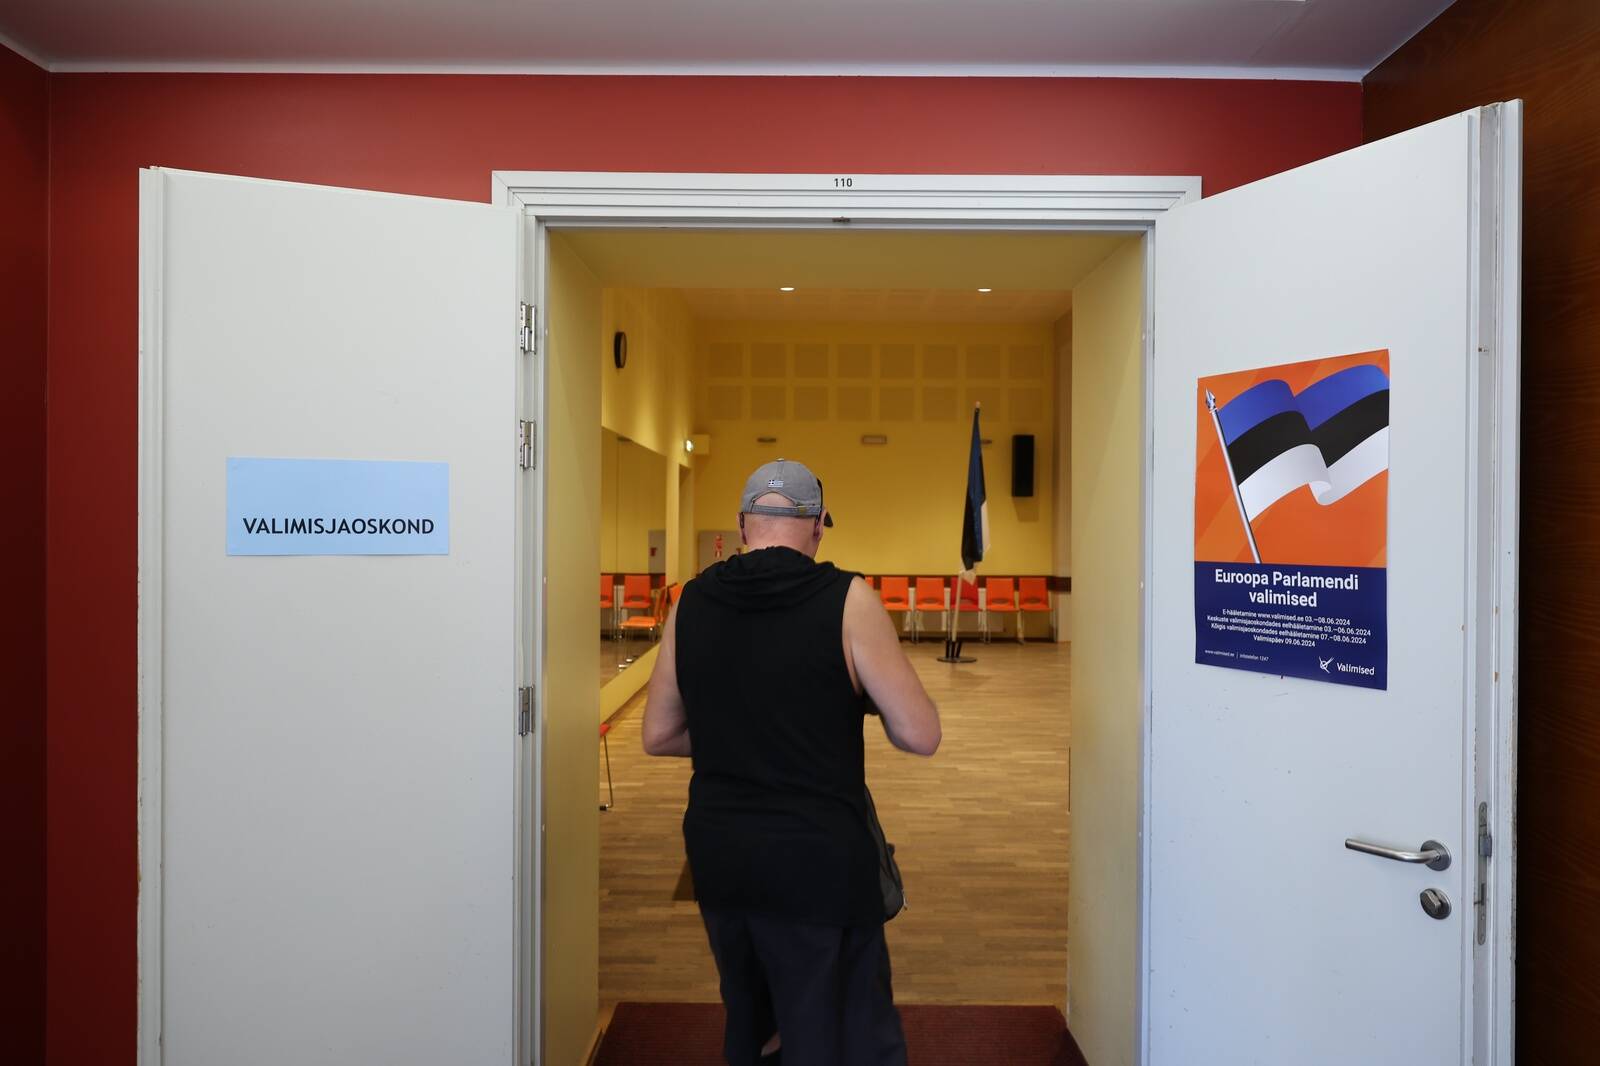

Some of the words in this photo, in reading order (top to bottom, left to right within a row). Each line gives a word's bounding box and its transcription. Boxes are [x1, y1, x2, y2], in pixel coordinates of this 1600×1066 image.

[834, 178, 853, 187] 110
[243, 518, 434, 535] VALIMISJAOSKOND
[1215, 569, 1269, 587] Euroopa
[1273, 571, 1359, 590] Parlamendi
[1249, 590, 1317, 607] valimised
[1222, 609, 1257, 618] E-hääletamine
[1257, 612, 1304, 622] www.valimised.ee
[1229, 617, 1281, 627] valimisjaoskondades
[1227, 625, 1278, 635] valimisjaoskondades
[1253, 635, 1284, 644] Valimispäev
[1285, 639, 1316, 647] 09.06.2024
[1336, 662, 1375, 675] Valimised
